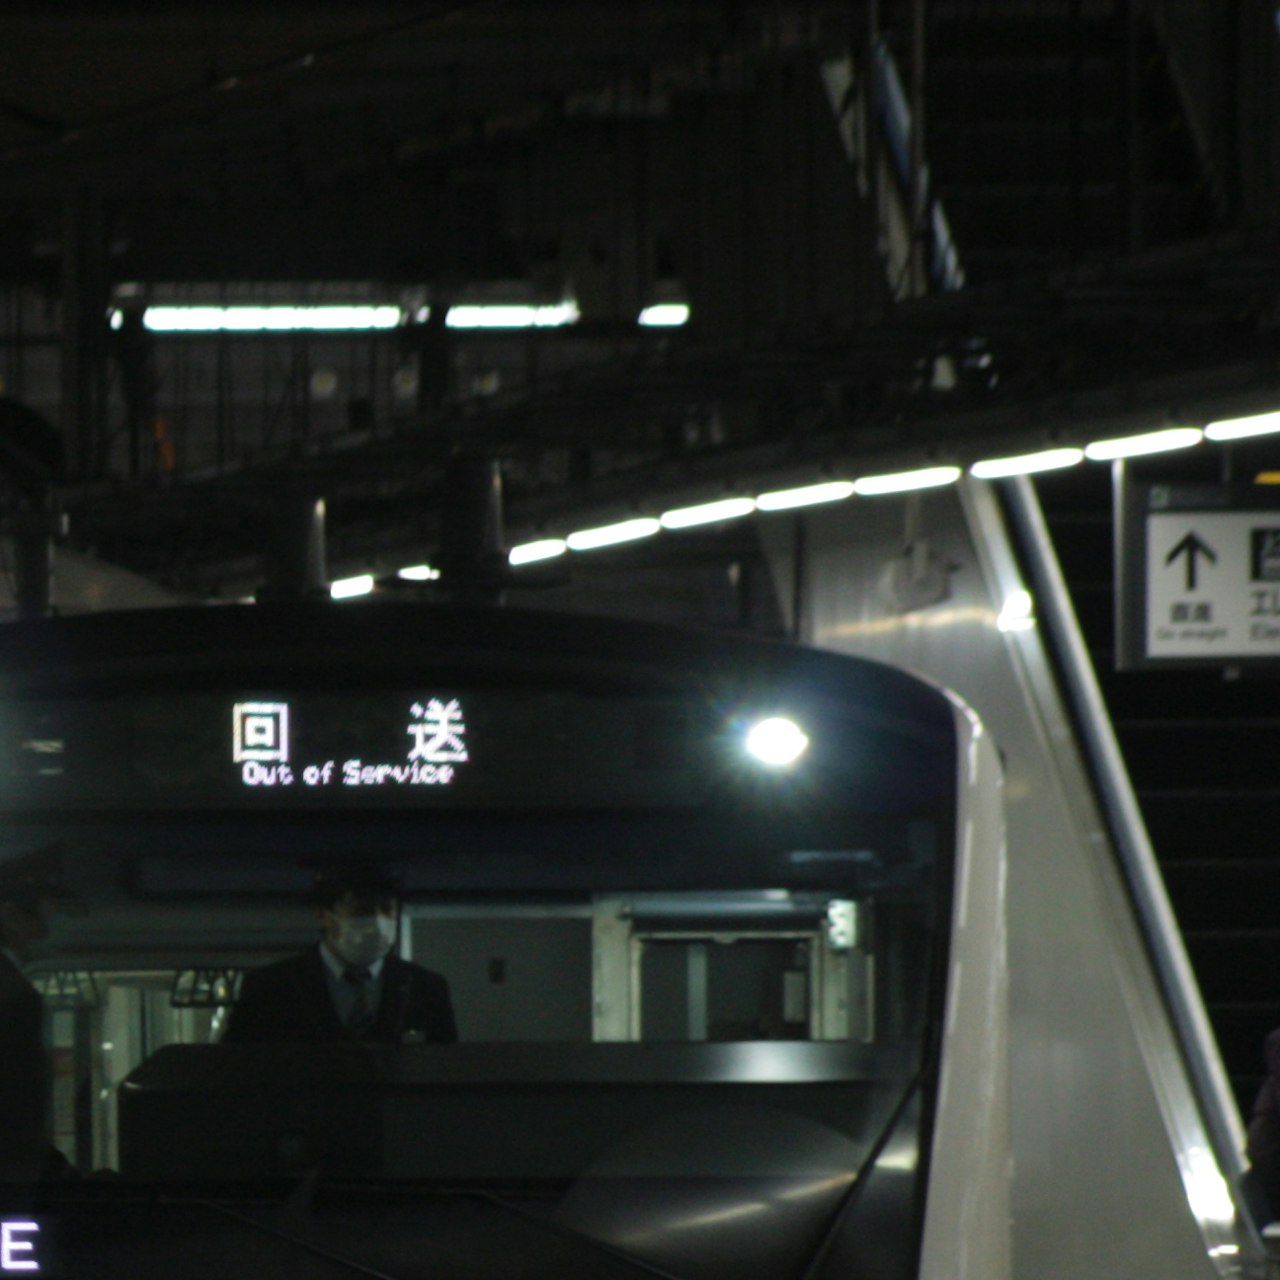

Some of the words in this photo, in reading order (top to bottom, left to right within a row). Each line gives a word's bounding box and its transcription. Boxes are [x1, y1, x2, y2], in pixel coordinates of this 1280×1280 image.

[242, 760, 294, 786] Out
[303, 760, 335, 786] of
[342, 758, 454, 786] Service
